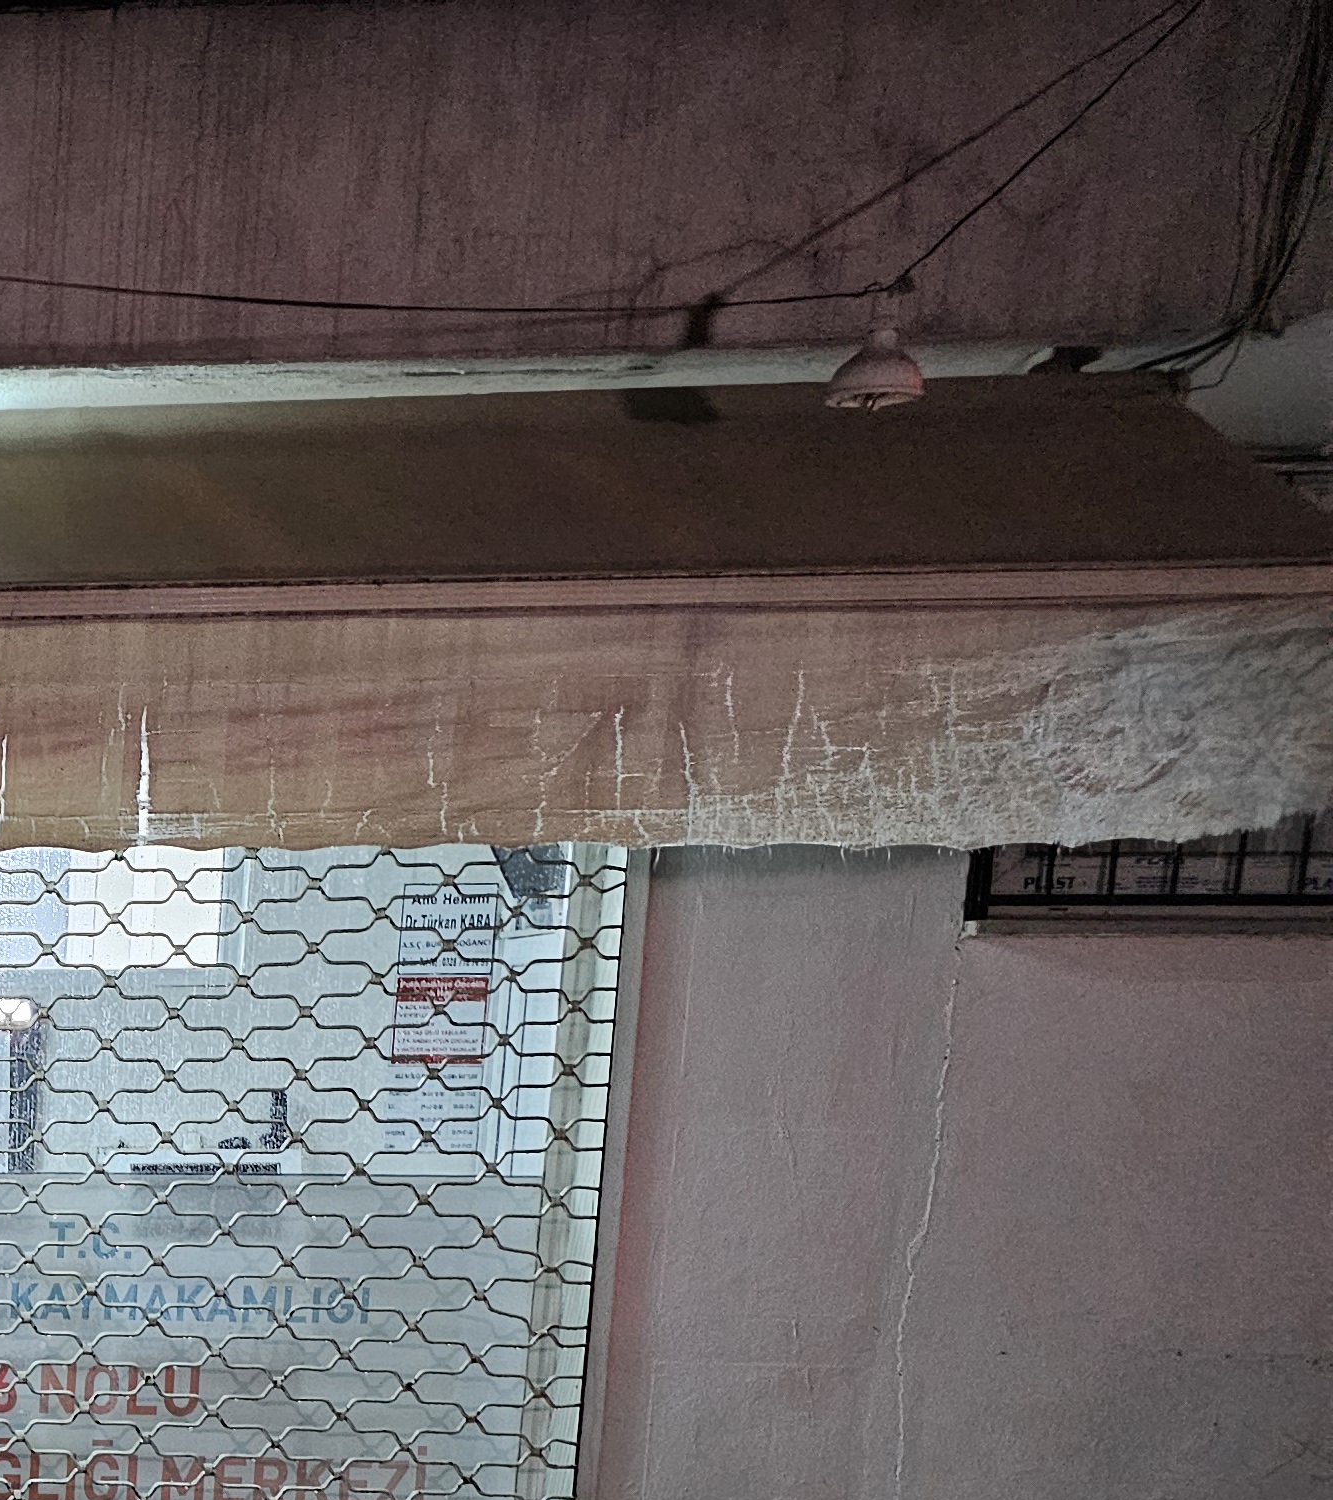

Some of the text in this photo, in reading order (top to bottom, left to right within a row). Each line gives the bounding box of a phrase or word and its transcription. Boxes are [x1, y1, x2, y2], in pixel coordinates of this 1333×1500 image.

[460, 913, 491, 929] KARA
[49, 1221, 132, 1259] T.C.
[10, 1277, 371, 1324] KAYMAKAMLIĞI
[39, 1362, 201, 1417] NOLU
